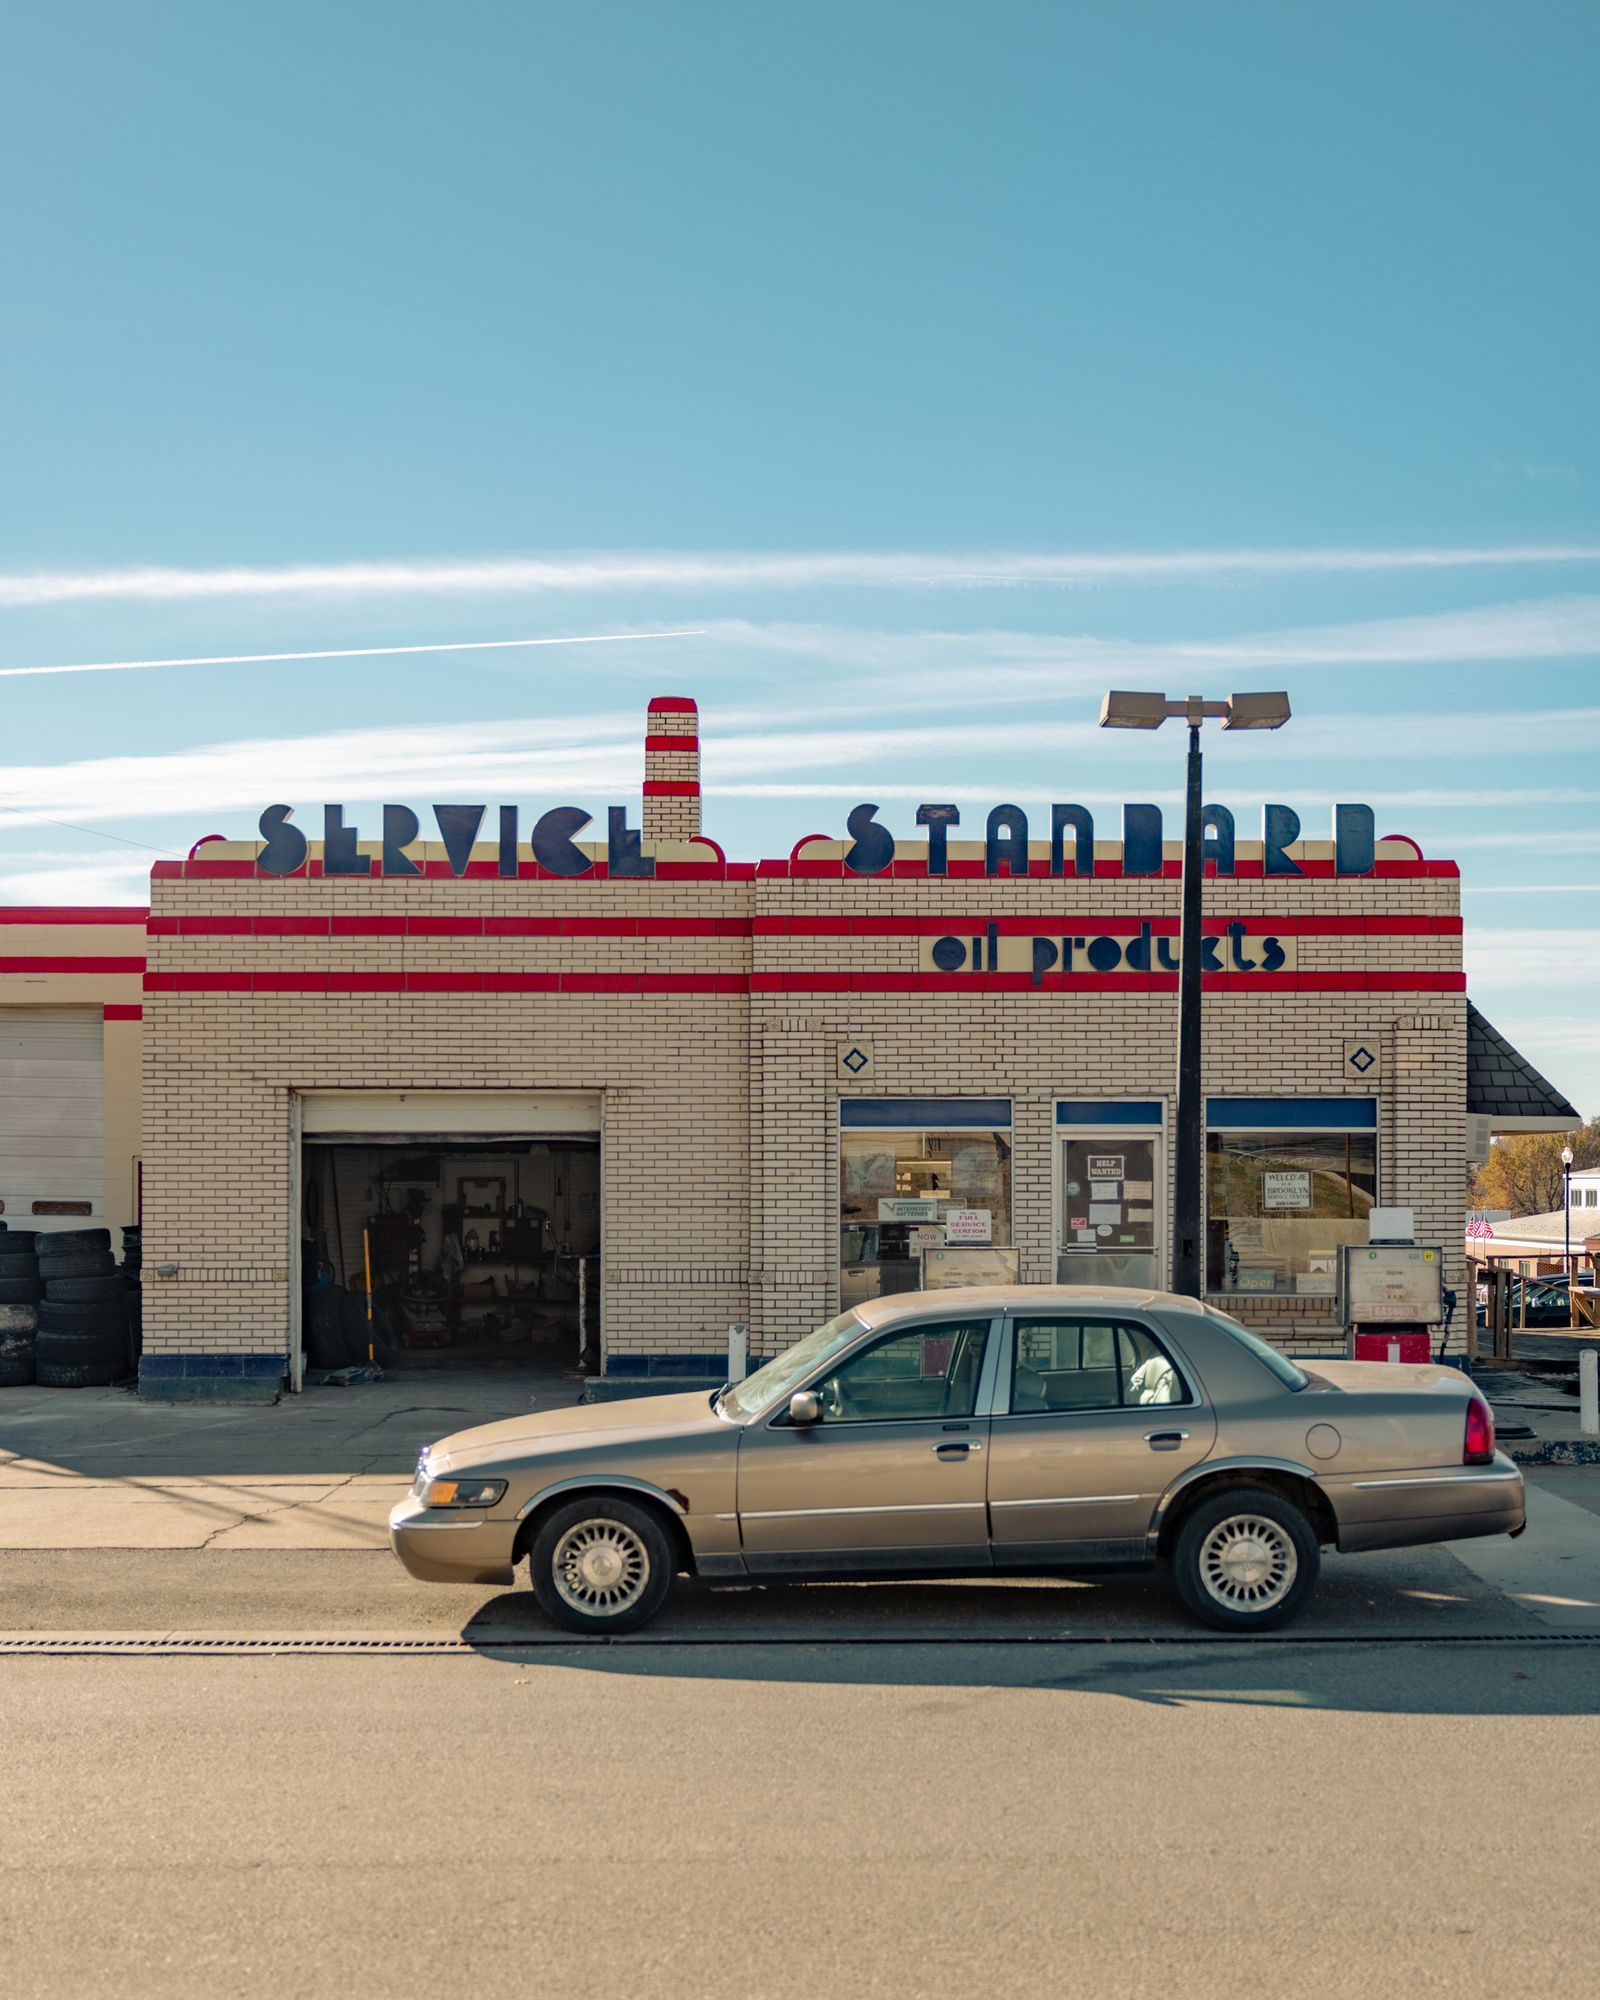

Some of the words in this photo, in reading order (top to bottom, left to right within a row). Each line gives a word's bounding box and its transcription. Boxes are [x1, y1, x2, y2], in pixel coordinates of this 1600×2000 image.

[256, 803, 656, 877] SERVICE
[844, 803, 1375, 876] STANDARD
[932, 922, 997, 971] oil
[1032, 921, 1287, 987] products
[1268, 1173, 1307, 1181] WELCOME
[917, 1233, 937, 1241] NOW
[1239, 1276, 1274, 1289] Open
